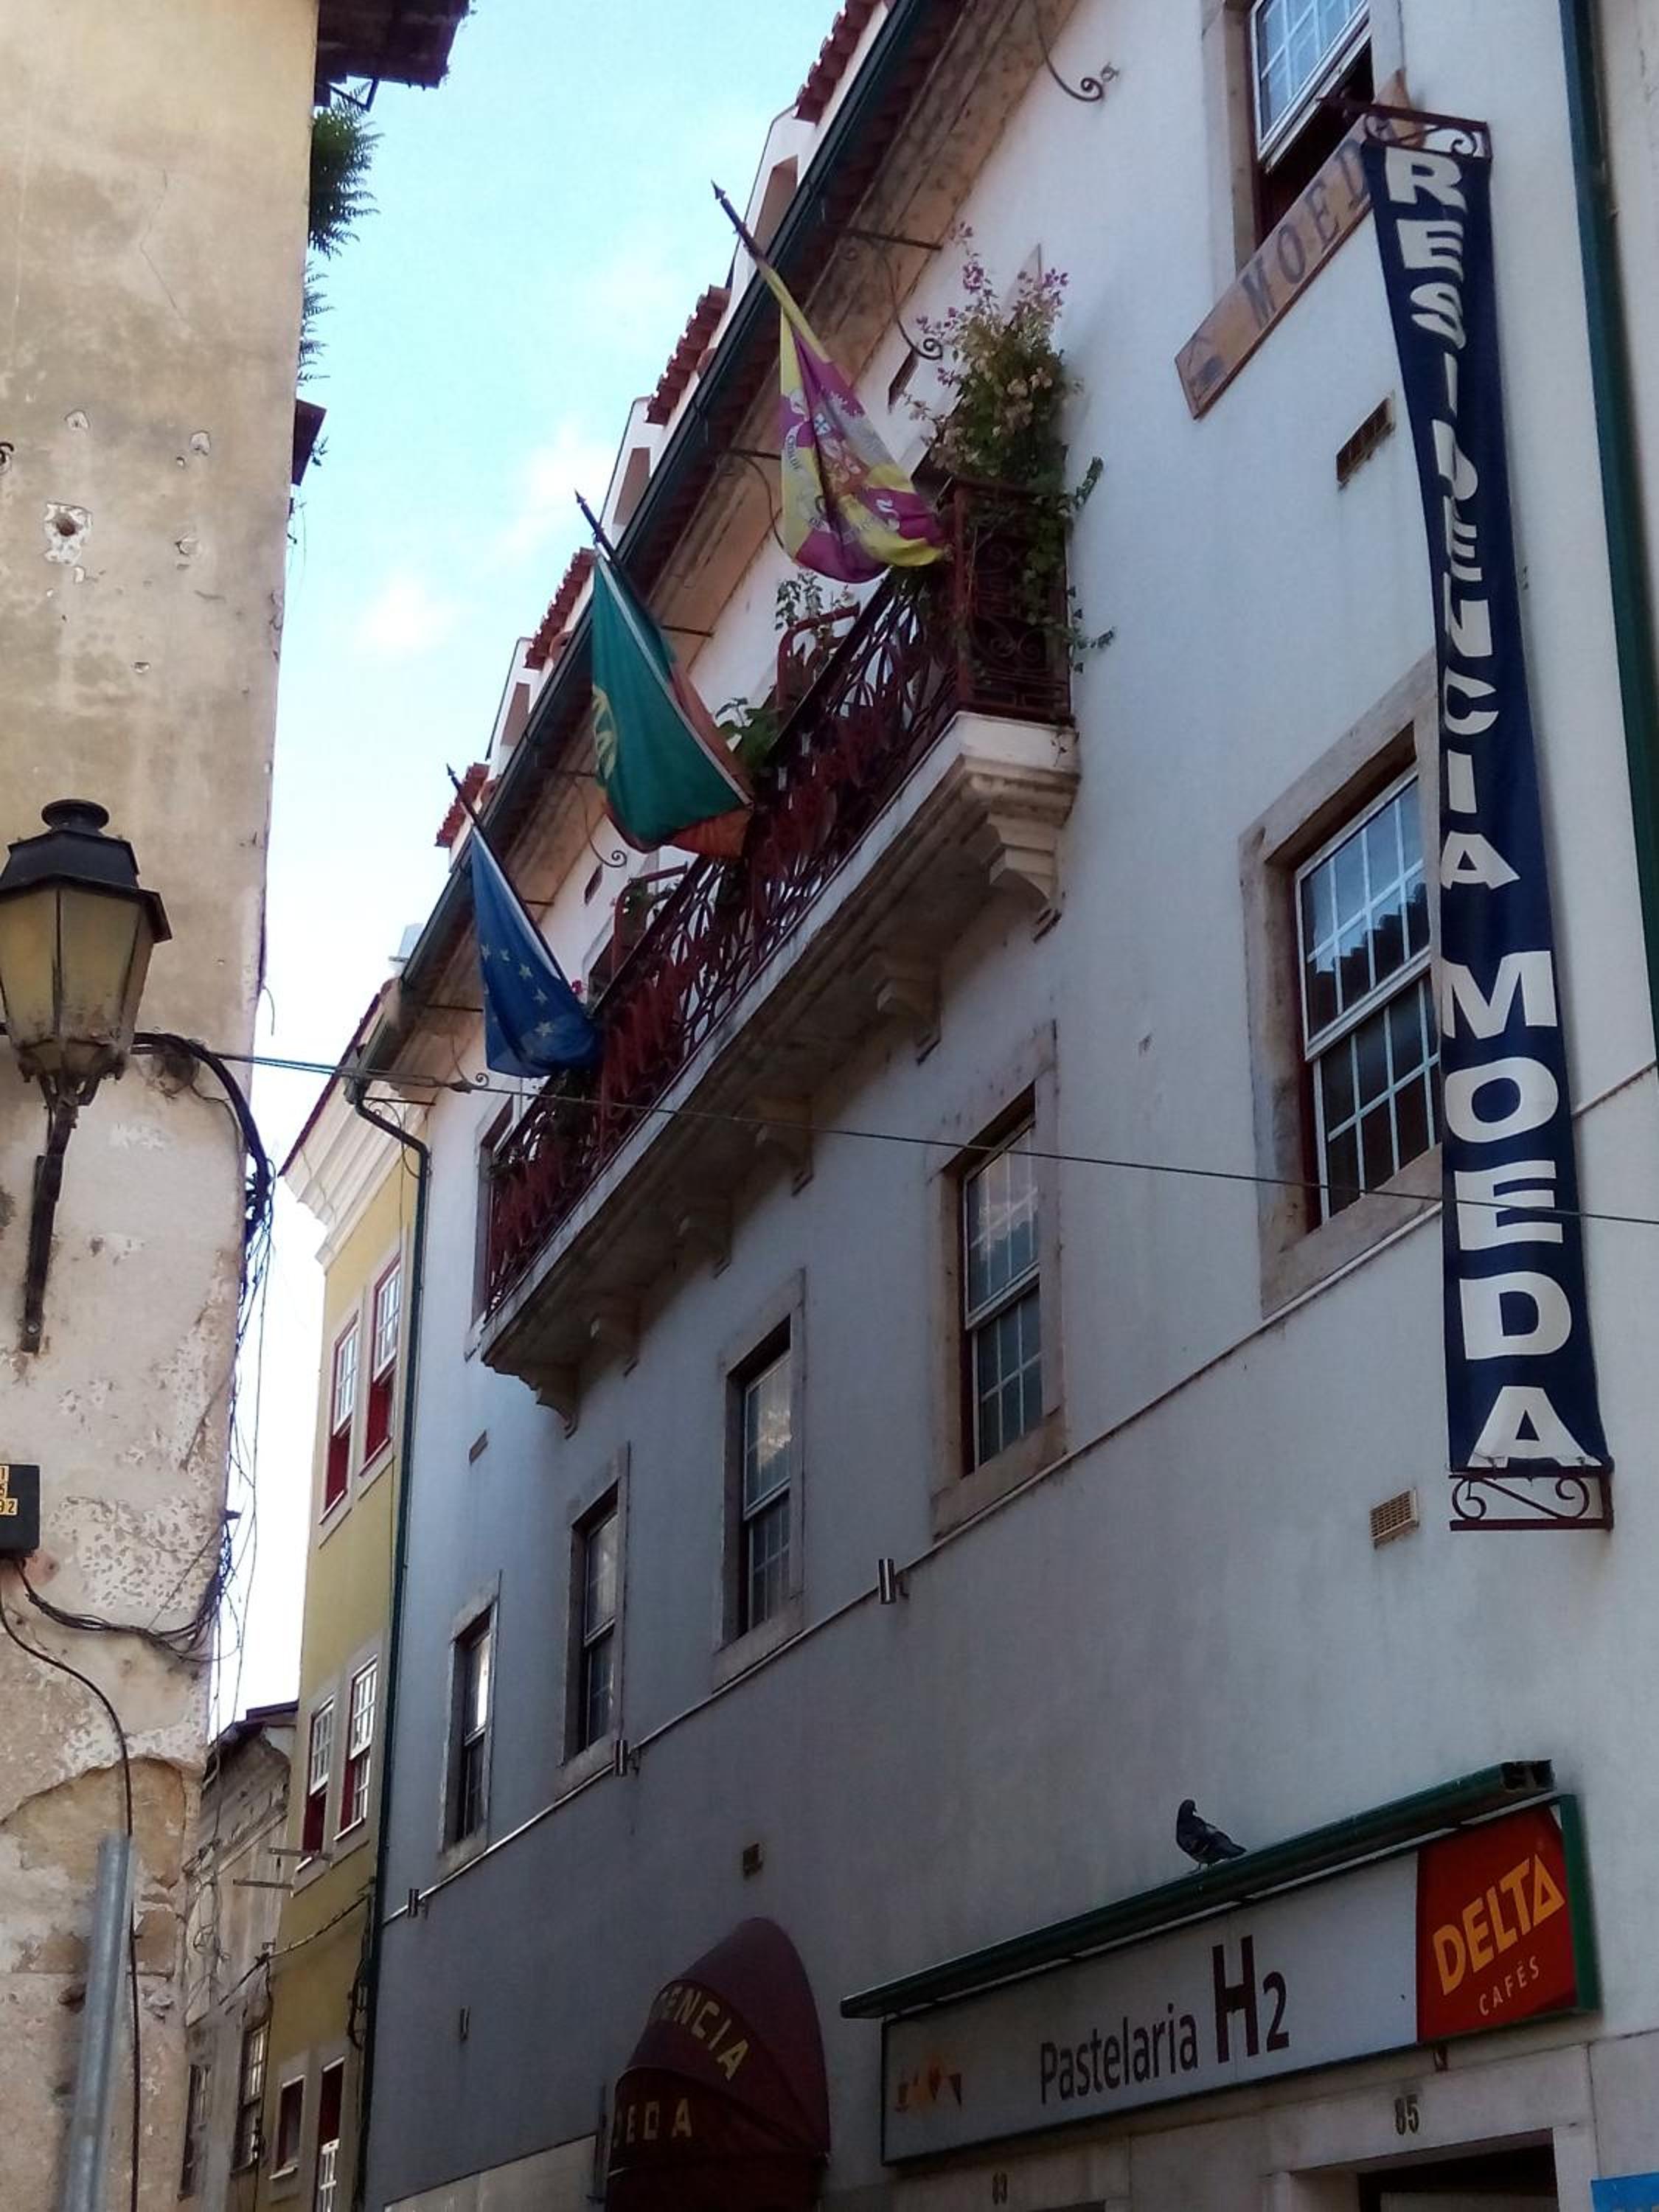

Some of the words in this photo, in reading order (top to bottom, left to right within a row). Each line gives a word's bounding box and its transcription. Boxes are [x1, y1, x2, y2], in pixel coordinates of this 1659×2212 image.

[1441, 950, 1602, 1470] MOEDA
[1433, 1853, 1566, 1996] DELTA
[1478, 1955, 1540, 2016] CAFÉS
[1040, 2003, 1199, 2105] Pastelaria
[1211, 1934, 1290, 2064] H2
